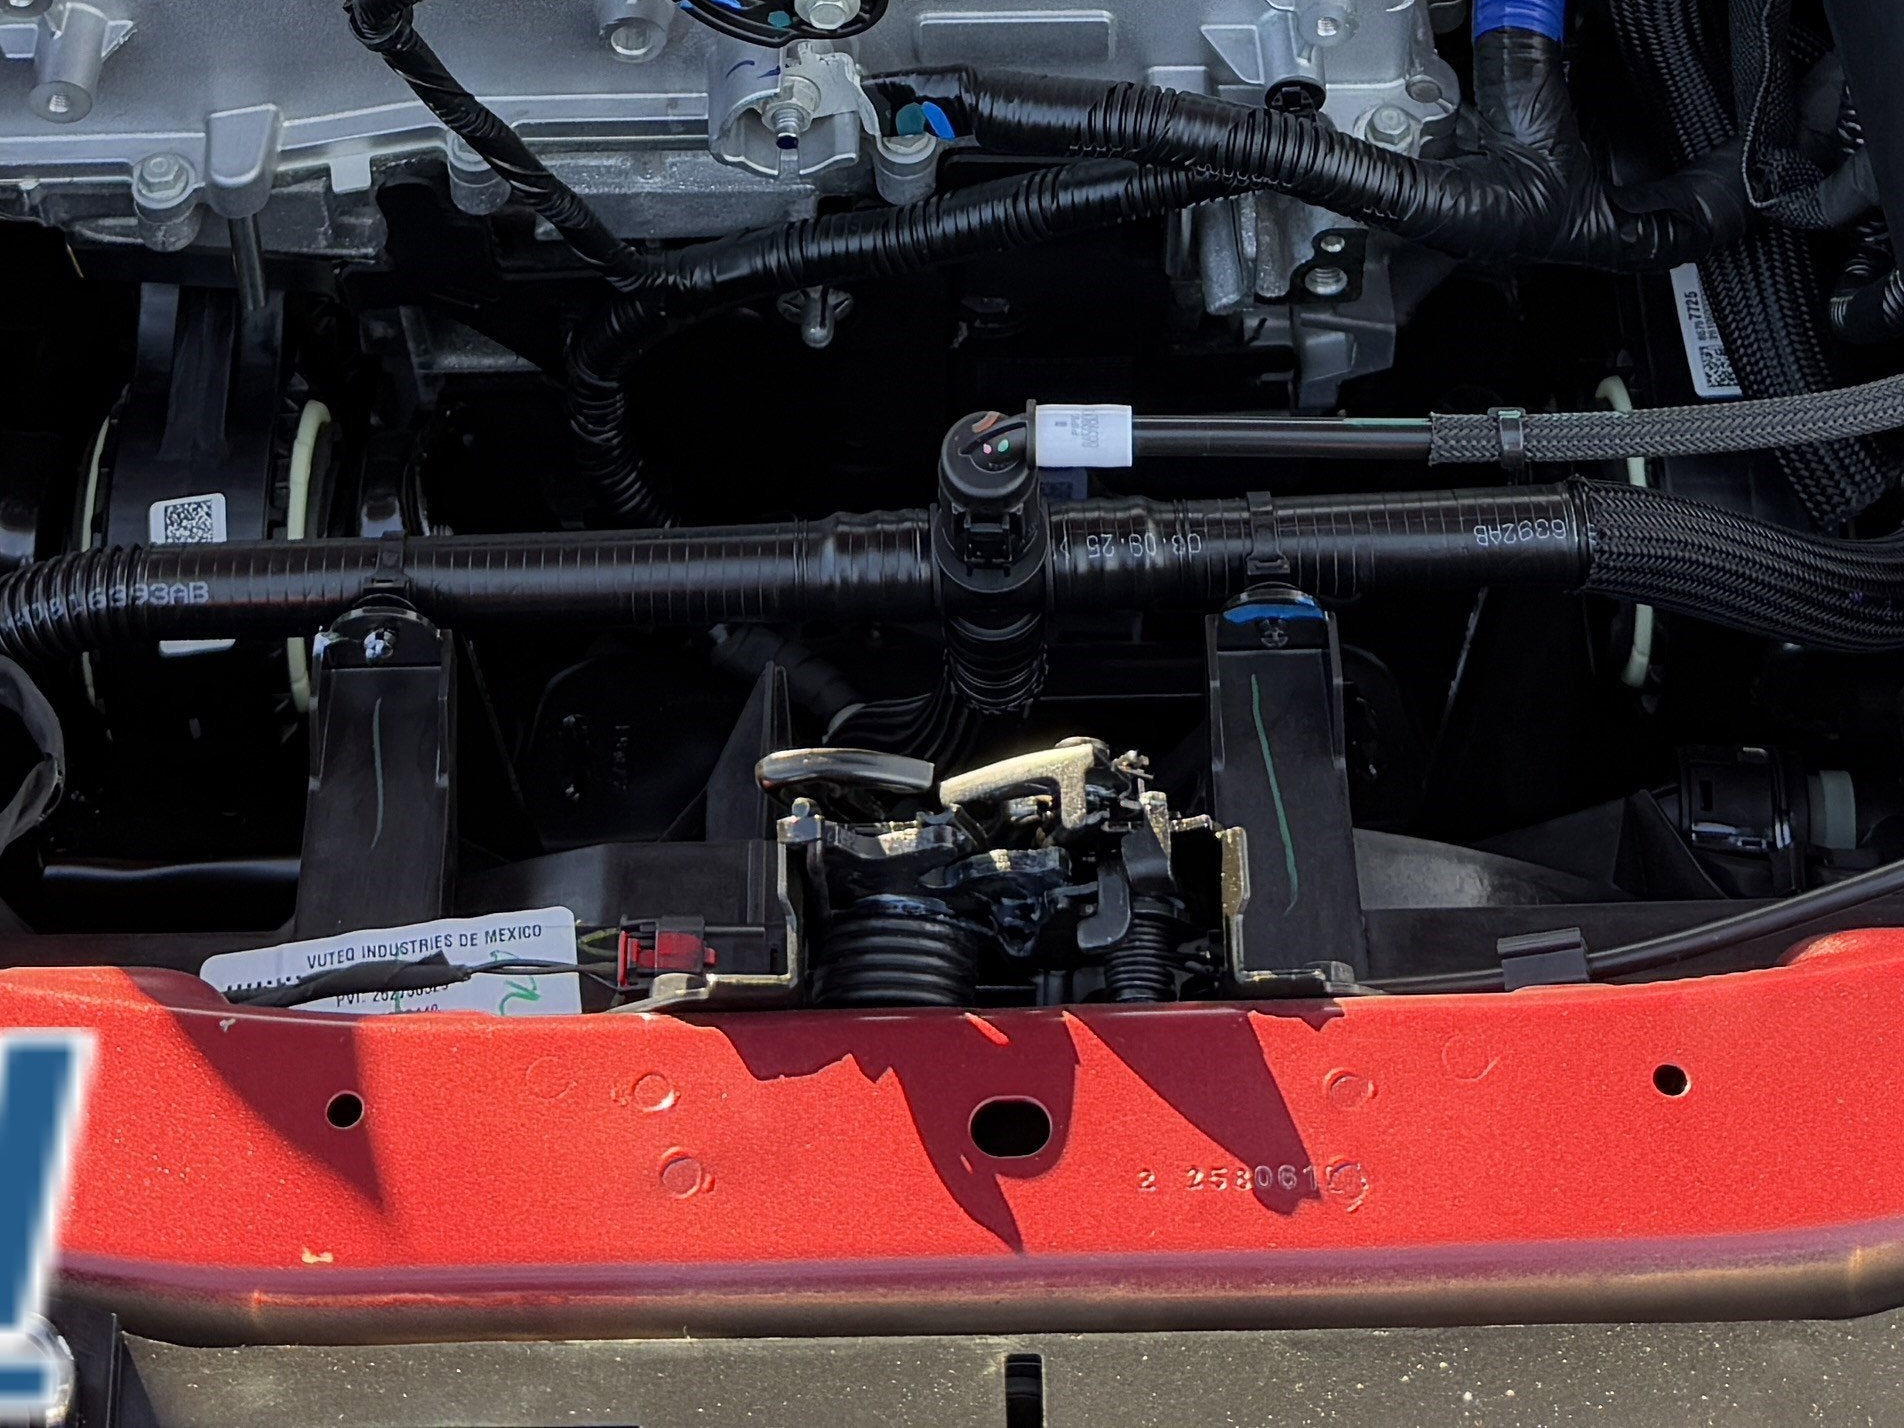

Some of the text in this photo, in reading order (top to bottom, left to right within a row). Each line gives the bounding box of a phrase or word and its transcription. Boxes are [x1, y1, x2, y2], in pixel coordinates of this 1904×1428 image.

[361, 933, 454, 960] INDUSTRIES
[459, 933, 478, 948] DE
[484, 923, 543, 945] MEXICO
